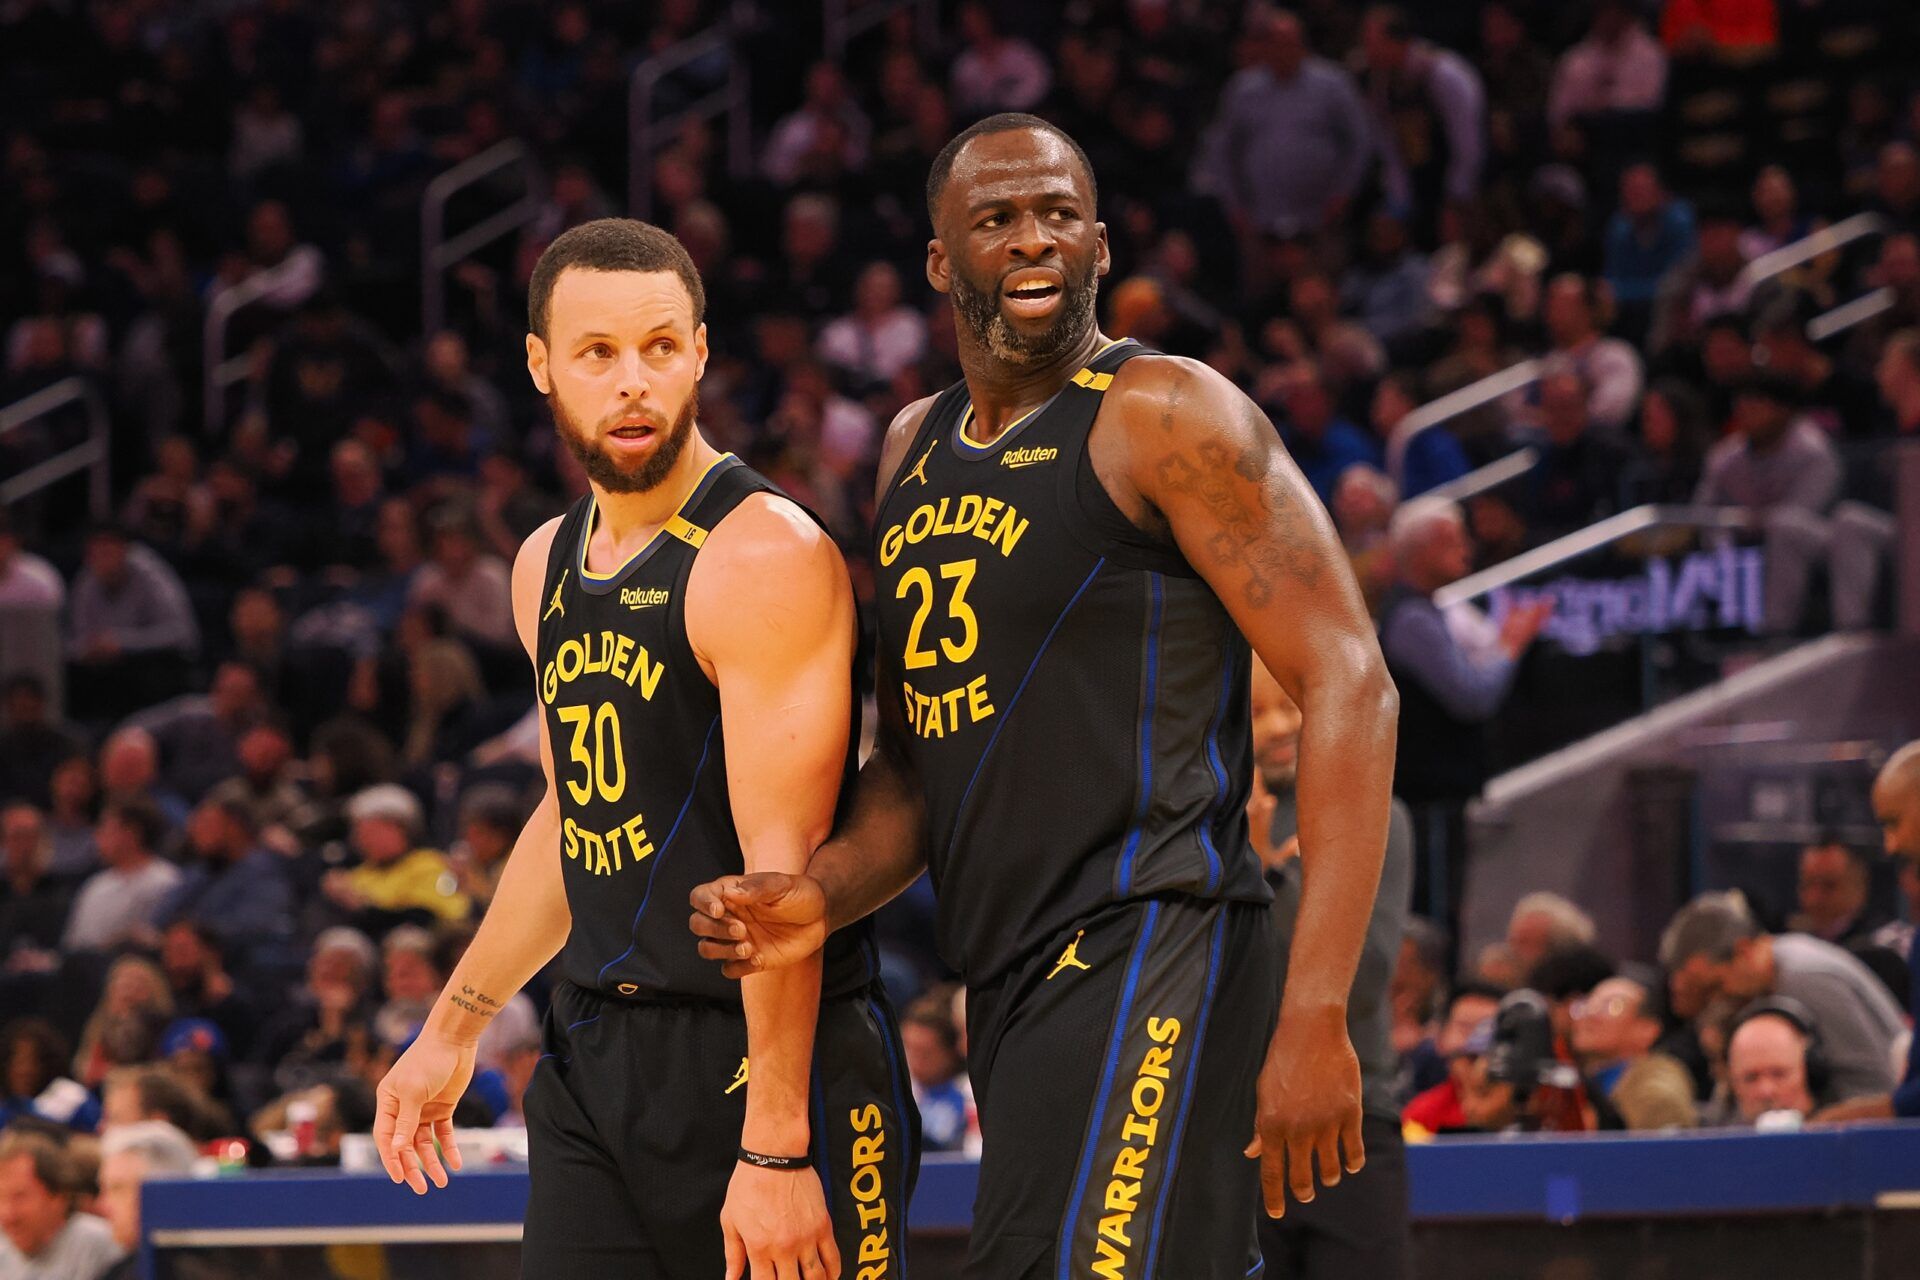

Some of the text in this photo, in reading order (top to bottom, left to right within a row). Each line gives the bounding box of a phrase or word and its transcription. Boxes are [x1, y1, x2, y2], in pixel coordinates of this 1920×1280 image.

[1000, 446, 1058, 466] Rakuten
[684, 525, 697, 540] 16
[880, 494, 1029, 566] GOLDEN
[620, 586, 669, 606] Rakuten
[896, 558, 979, 670] 23
[543, 630, 665, 705] GOLDEN
[903, 674, 995, 739] STATE
[556, 701, 626, 806] 30
[563, 813, 655, 876] STATE
[768, 1157, 790, 1165] ACTIVE
[1091, 1016, 1181, 1280] WARRIORS
